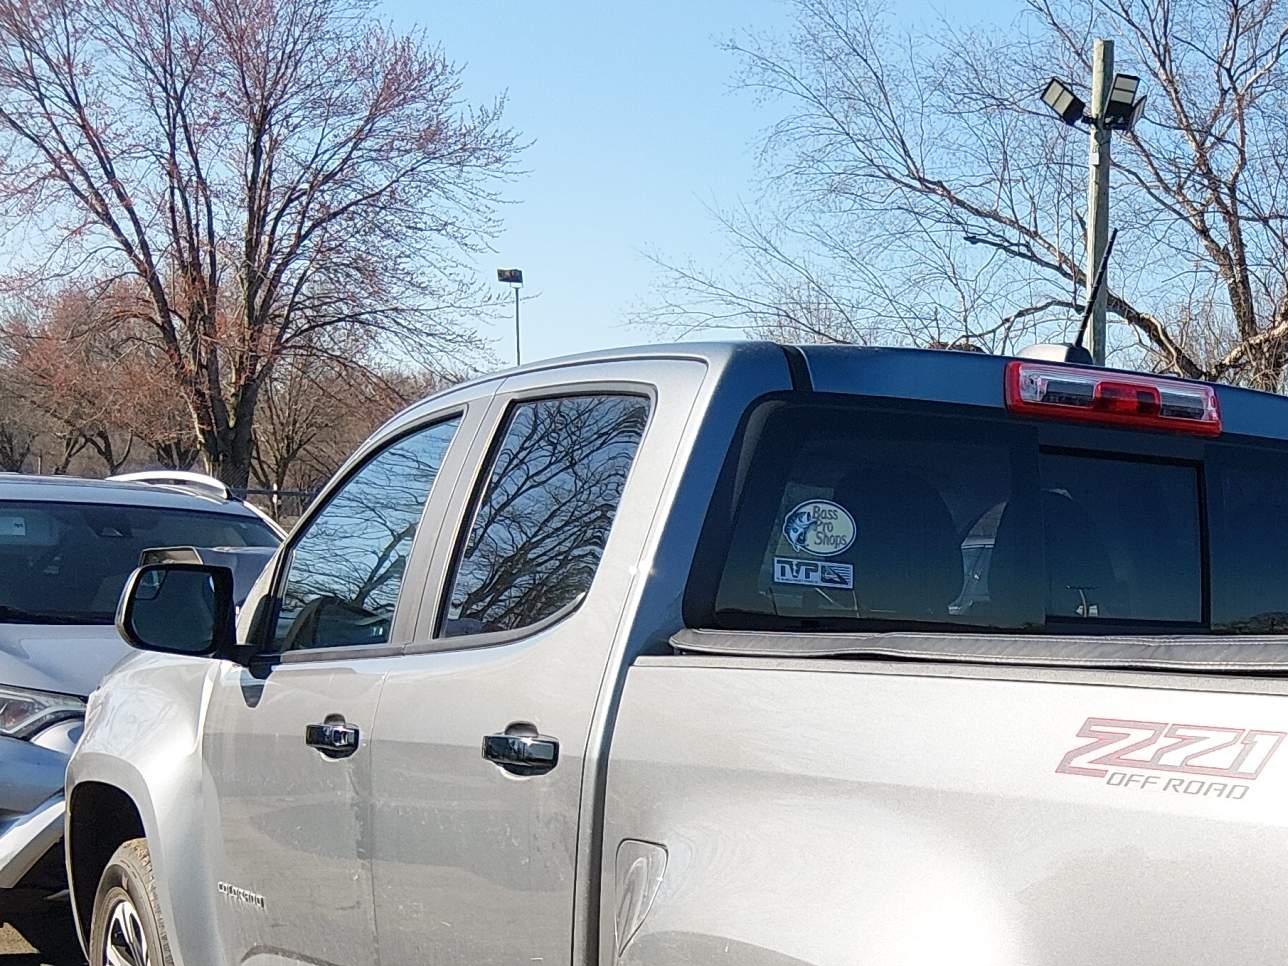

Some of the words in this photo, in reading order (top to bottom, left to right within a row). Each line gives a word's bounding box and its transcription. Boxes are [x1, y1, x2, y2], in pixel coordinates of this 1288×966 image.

[812, 505, 838, 520] Bass
[814, 520, 834, 533] Pro
[814, 531, 847, 548] Shops
[1055, 717, 1288, 780] Z71
[1106, 771, 1158, 790] OFF
[1163, 777, 1250, 800] ROAD
